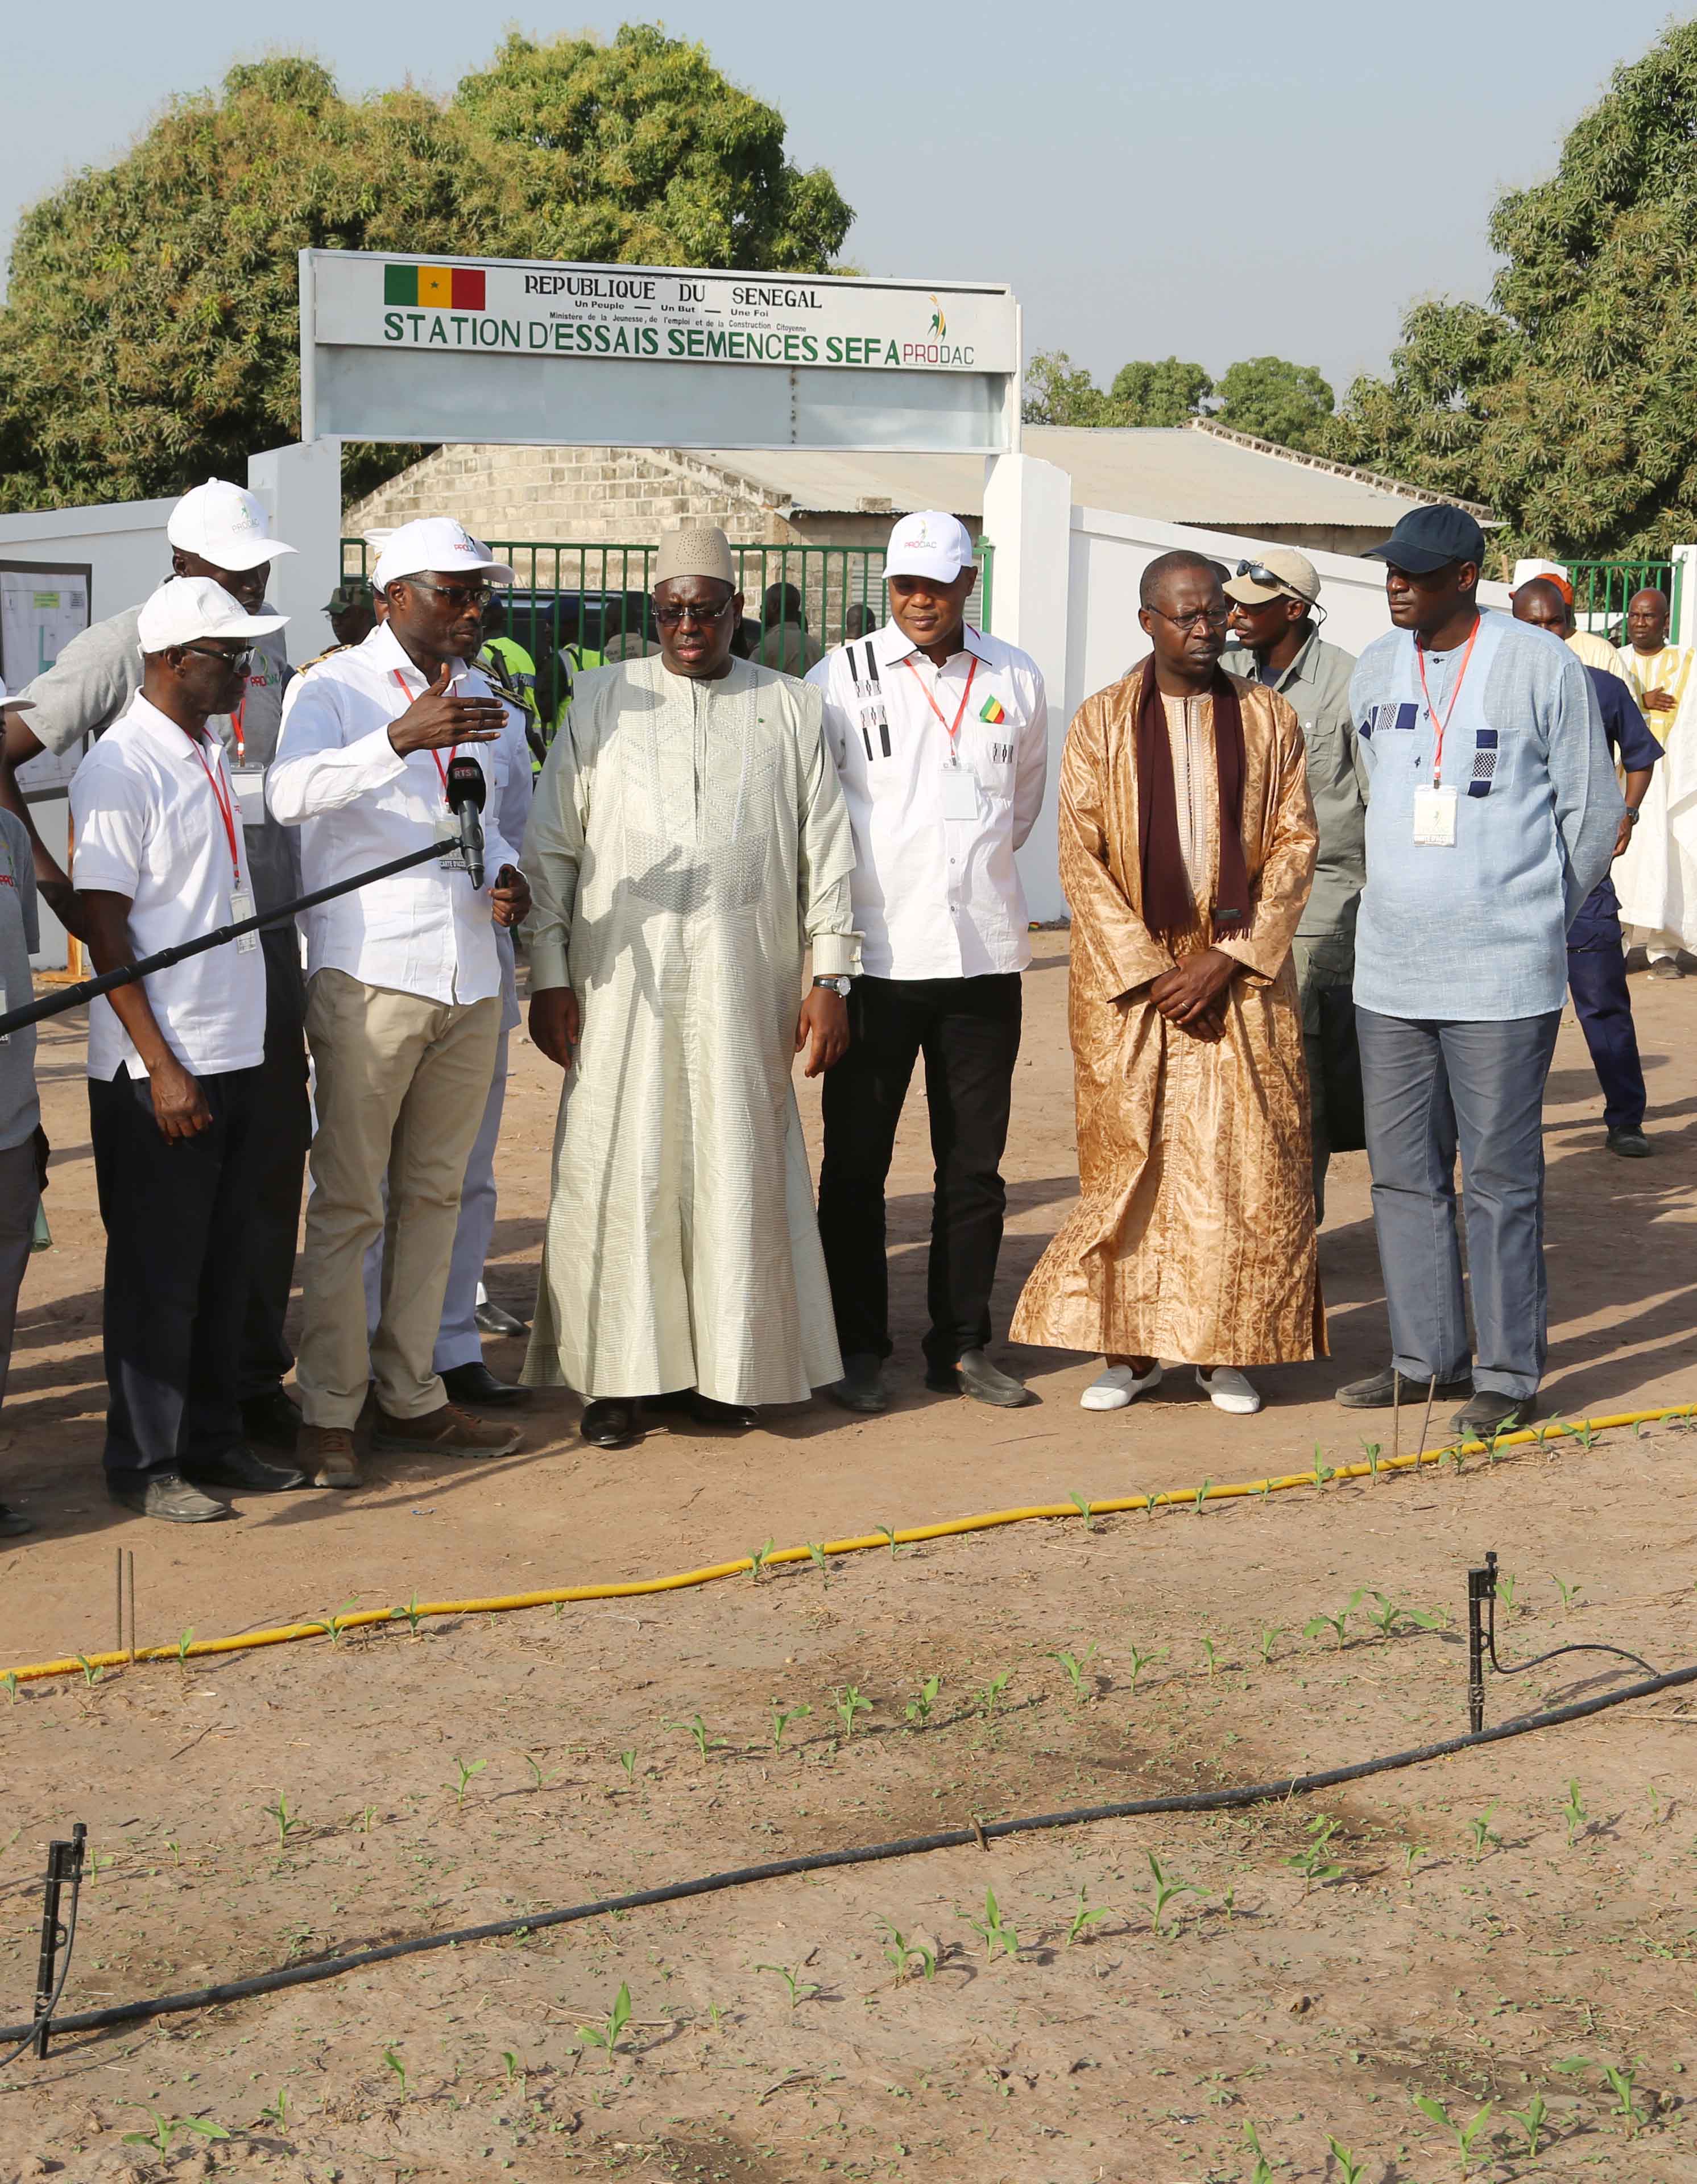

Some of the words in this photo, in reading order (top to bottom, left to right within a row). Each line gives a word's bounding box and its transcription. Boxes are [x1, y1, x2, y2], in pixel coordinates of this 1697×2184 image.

[525, 275, 655, 300] REPUBLIQUE
[679, 283, 705, 302] DU
[732, 287, 822, 308] SENEGAL
[591, 301, 624, 310] Peuple
[729, 320, 771, 329] Construction
[776, 323, 806, 332] Citoyenne
[384, 313, 520, 348] STATION
[529, 321, 659, 355] D'ESSAIS
[668, 329, 818, 361] SEMENCES
[903, 344, 974, 365] PRODAC
